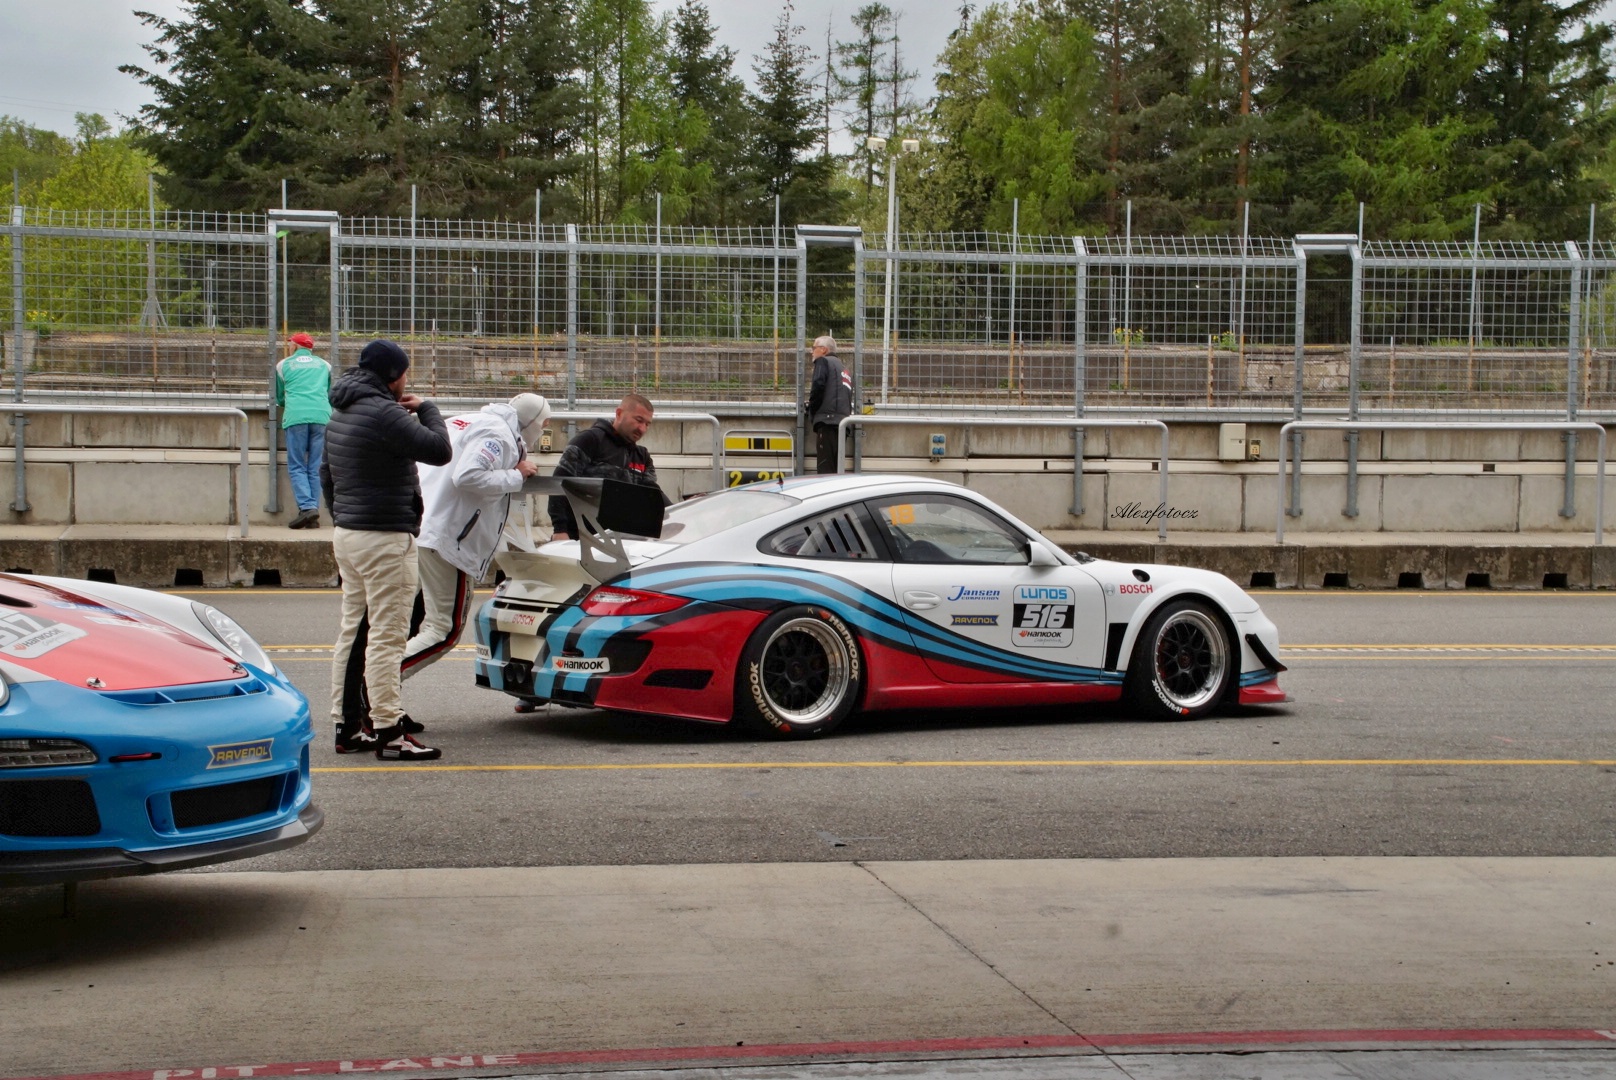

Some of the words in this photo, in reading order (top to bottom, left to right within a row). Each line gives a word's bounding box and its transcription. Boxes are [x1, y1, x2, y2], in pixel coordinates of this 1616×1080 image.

[947, 586, 1000, 601] Jansen
[1021, 588, 1067, 599] LUNOS
[1119, 584, 1153, 594] BOSCH
[512, 614, 535, 625] BOSCH
[1021, 604, 1068, 628] 516
[563, 661, 604, 670] HANKOOK
[216, 746, 268, 761] RAVENOL
[153, 1065, 268, 1080] PIT
[340, 1054, 520, 1071] LANE
